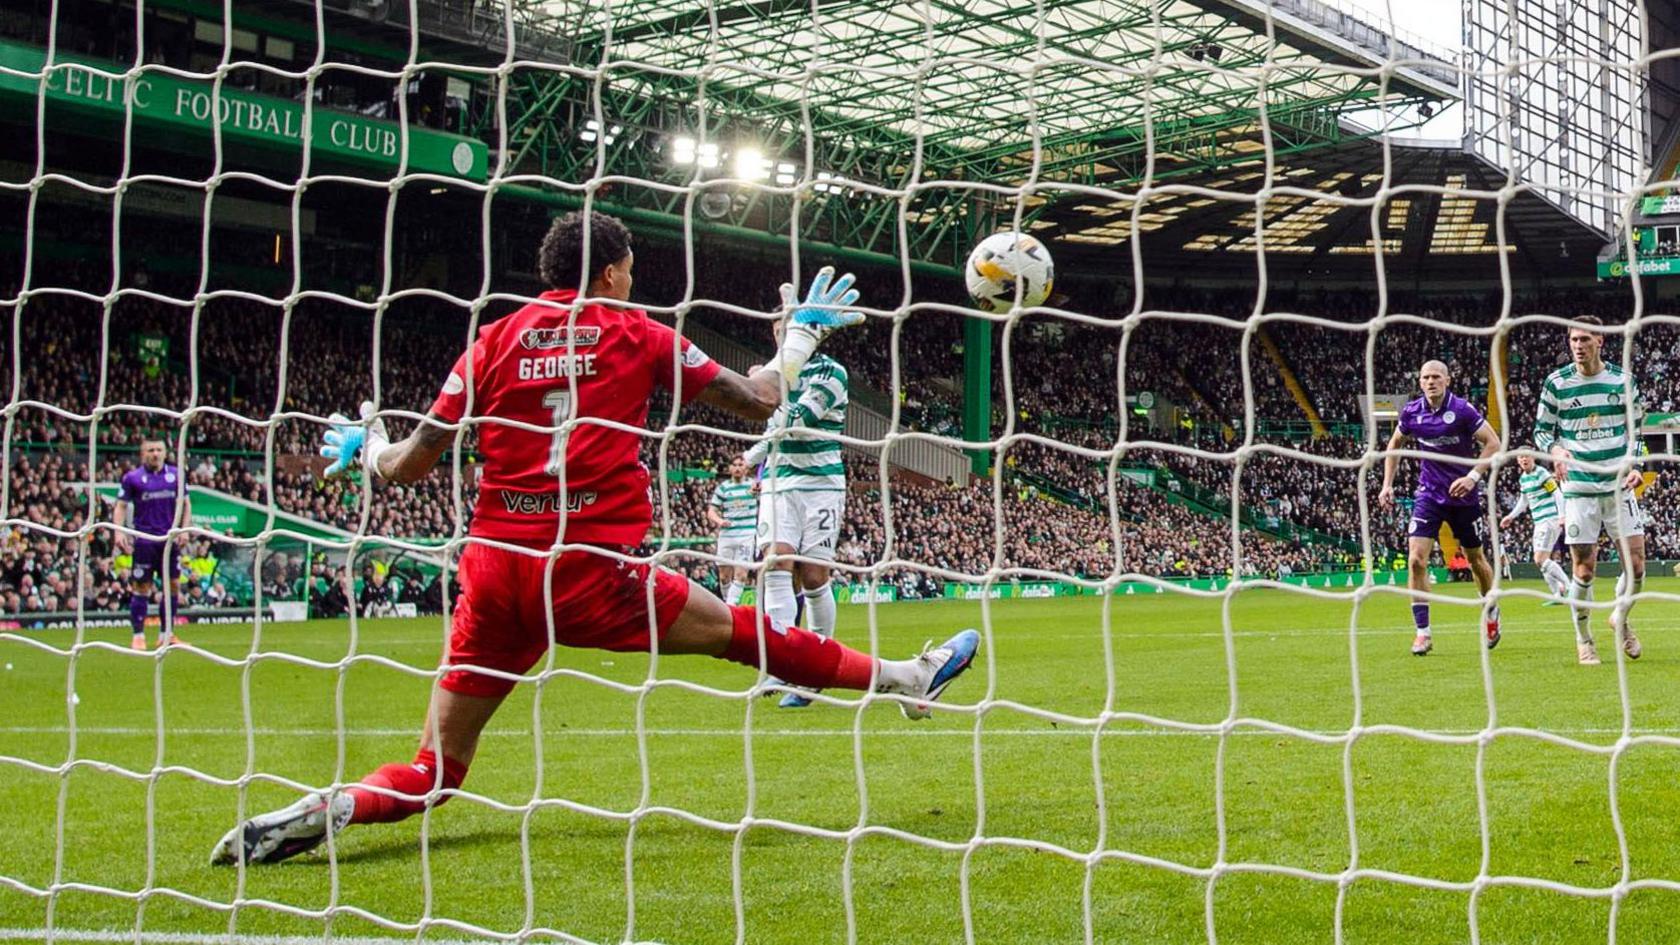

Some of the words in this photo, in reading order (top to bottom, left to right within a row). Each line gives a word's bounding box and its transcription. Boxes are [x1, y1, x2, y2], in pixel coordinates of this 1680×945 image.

[330, 120, 396, 157] CLUB
[518, 353, 598, 380] GEORGE
[542, 389, 571, 476] 1
[1575, 428, 1614, 440] dafabet
[501, 489, 582, 514] Vertu
[817, 508, 837, 531] 21
